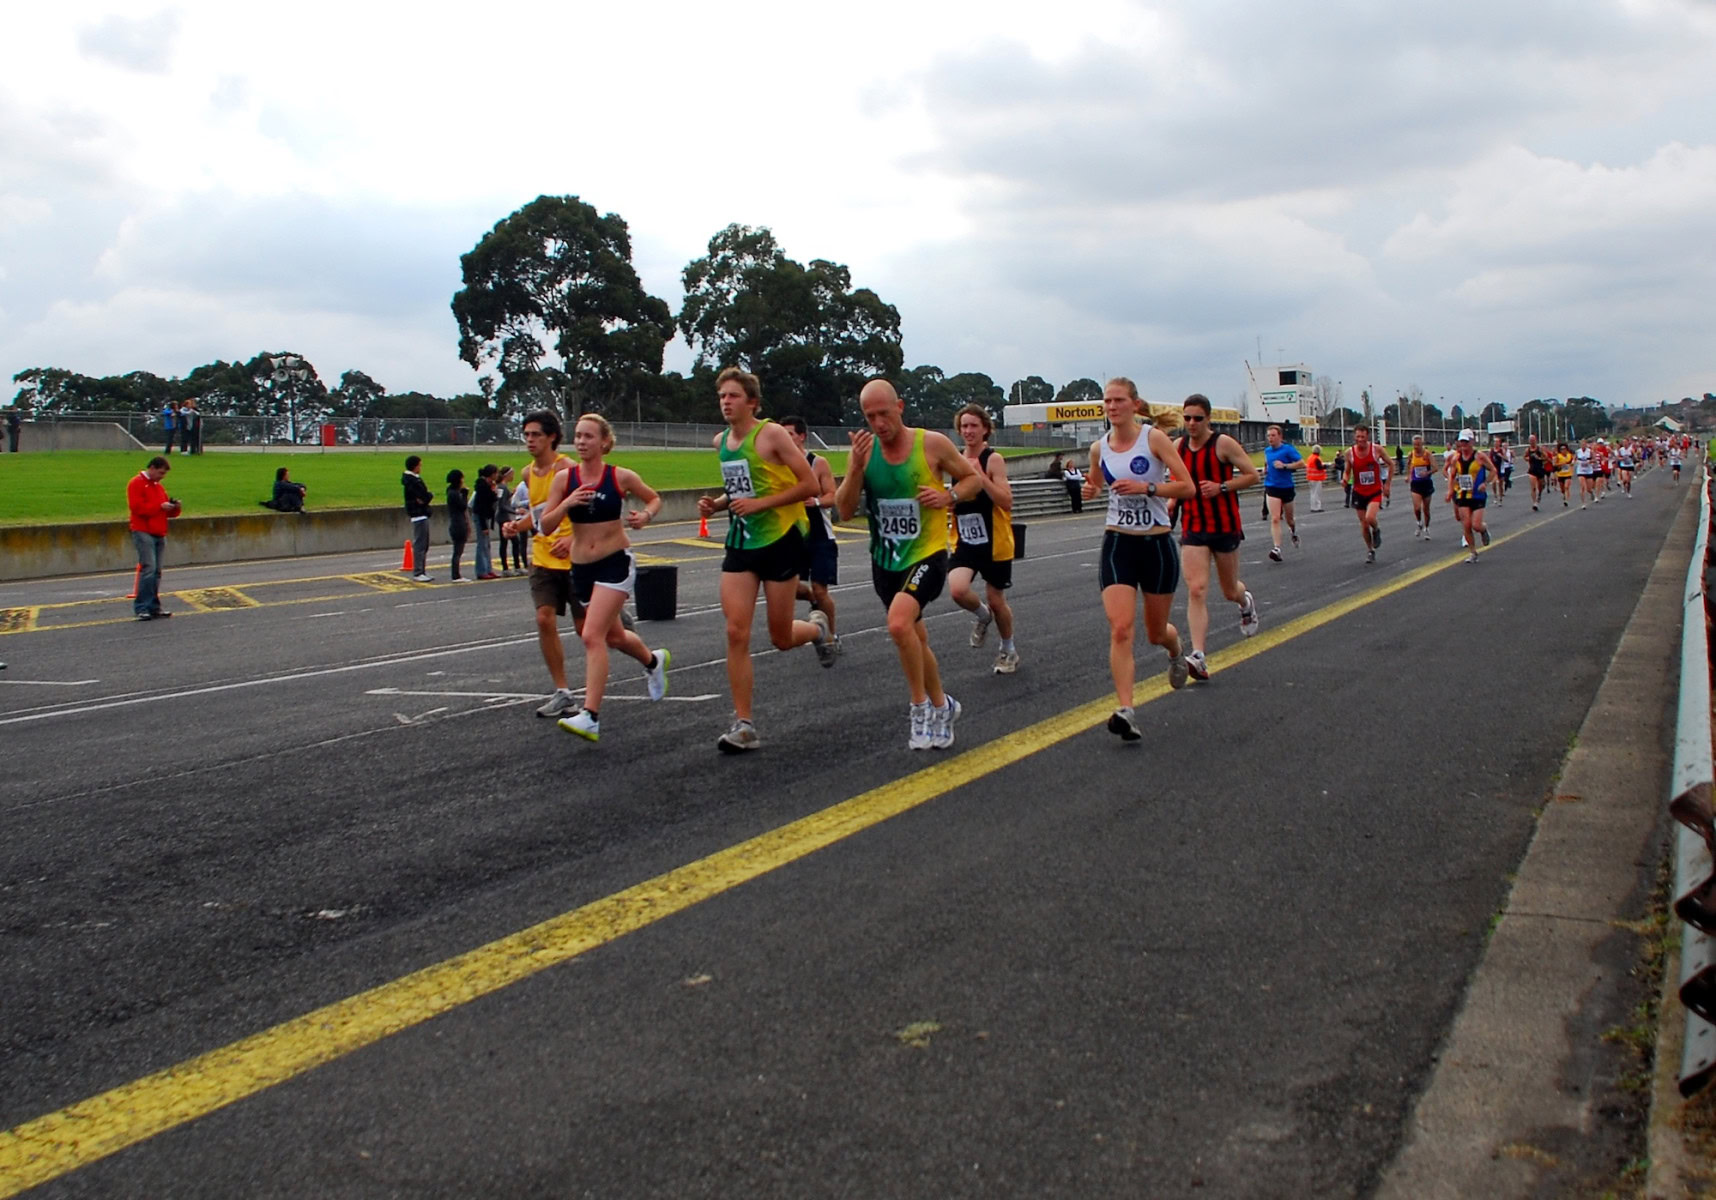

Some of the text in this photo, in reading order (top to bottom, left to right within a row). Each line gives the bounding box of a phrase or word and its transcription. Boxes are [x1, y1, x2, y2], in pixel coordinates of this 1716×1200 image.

[1056, 406, 1095, 418] Norton
[882, 517, 918, 535] 2496
[1118, 508, 1152, 526] 2610
